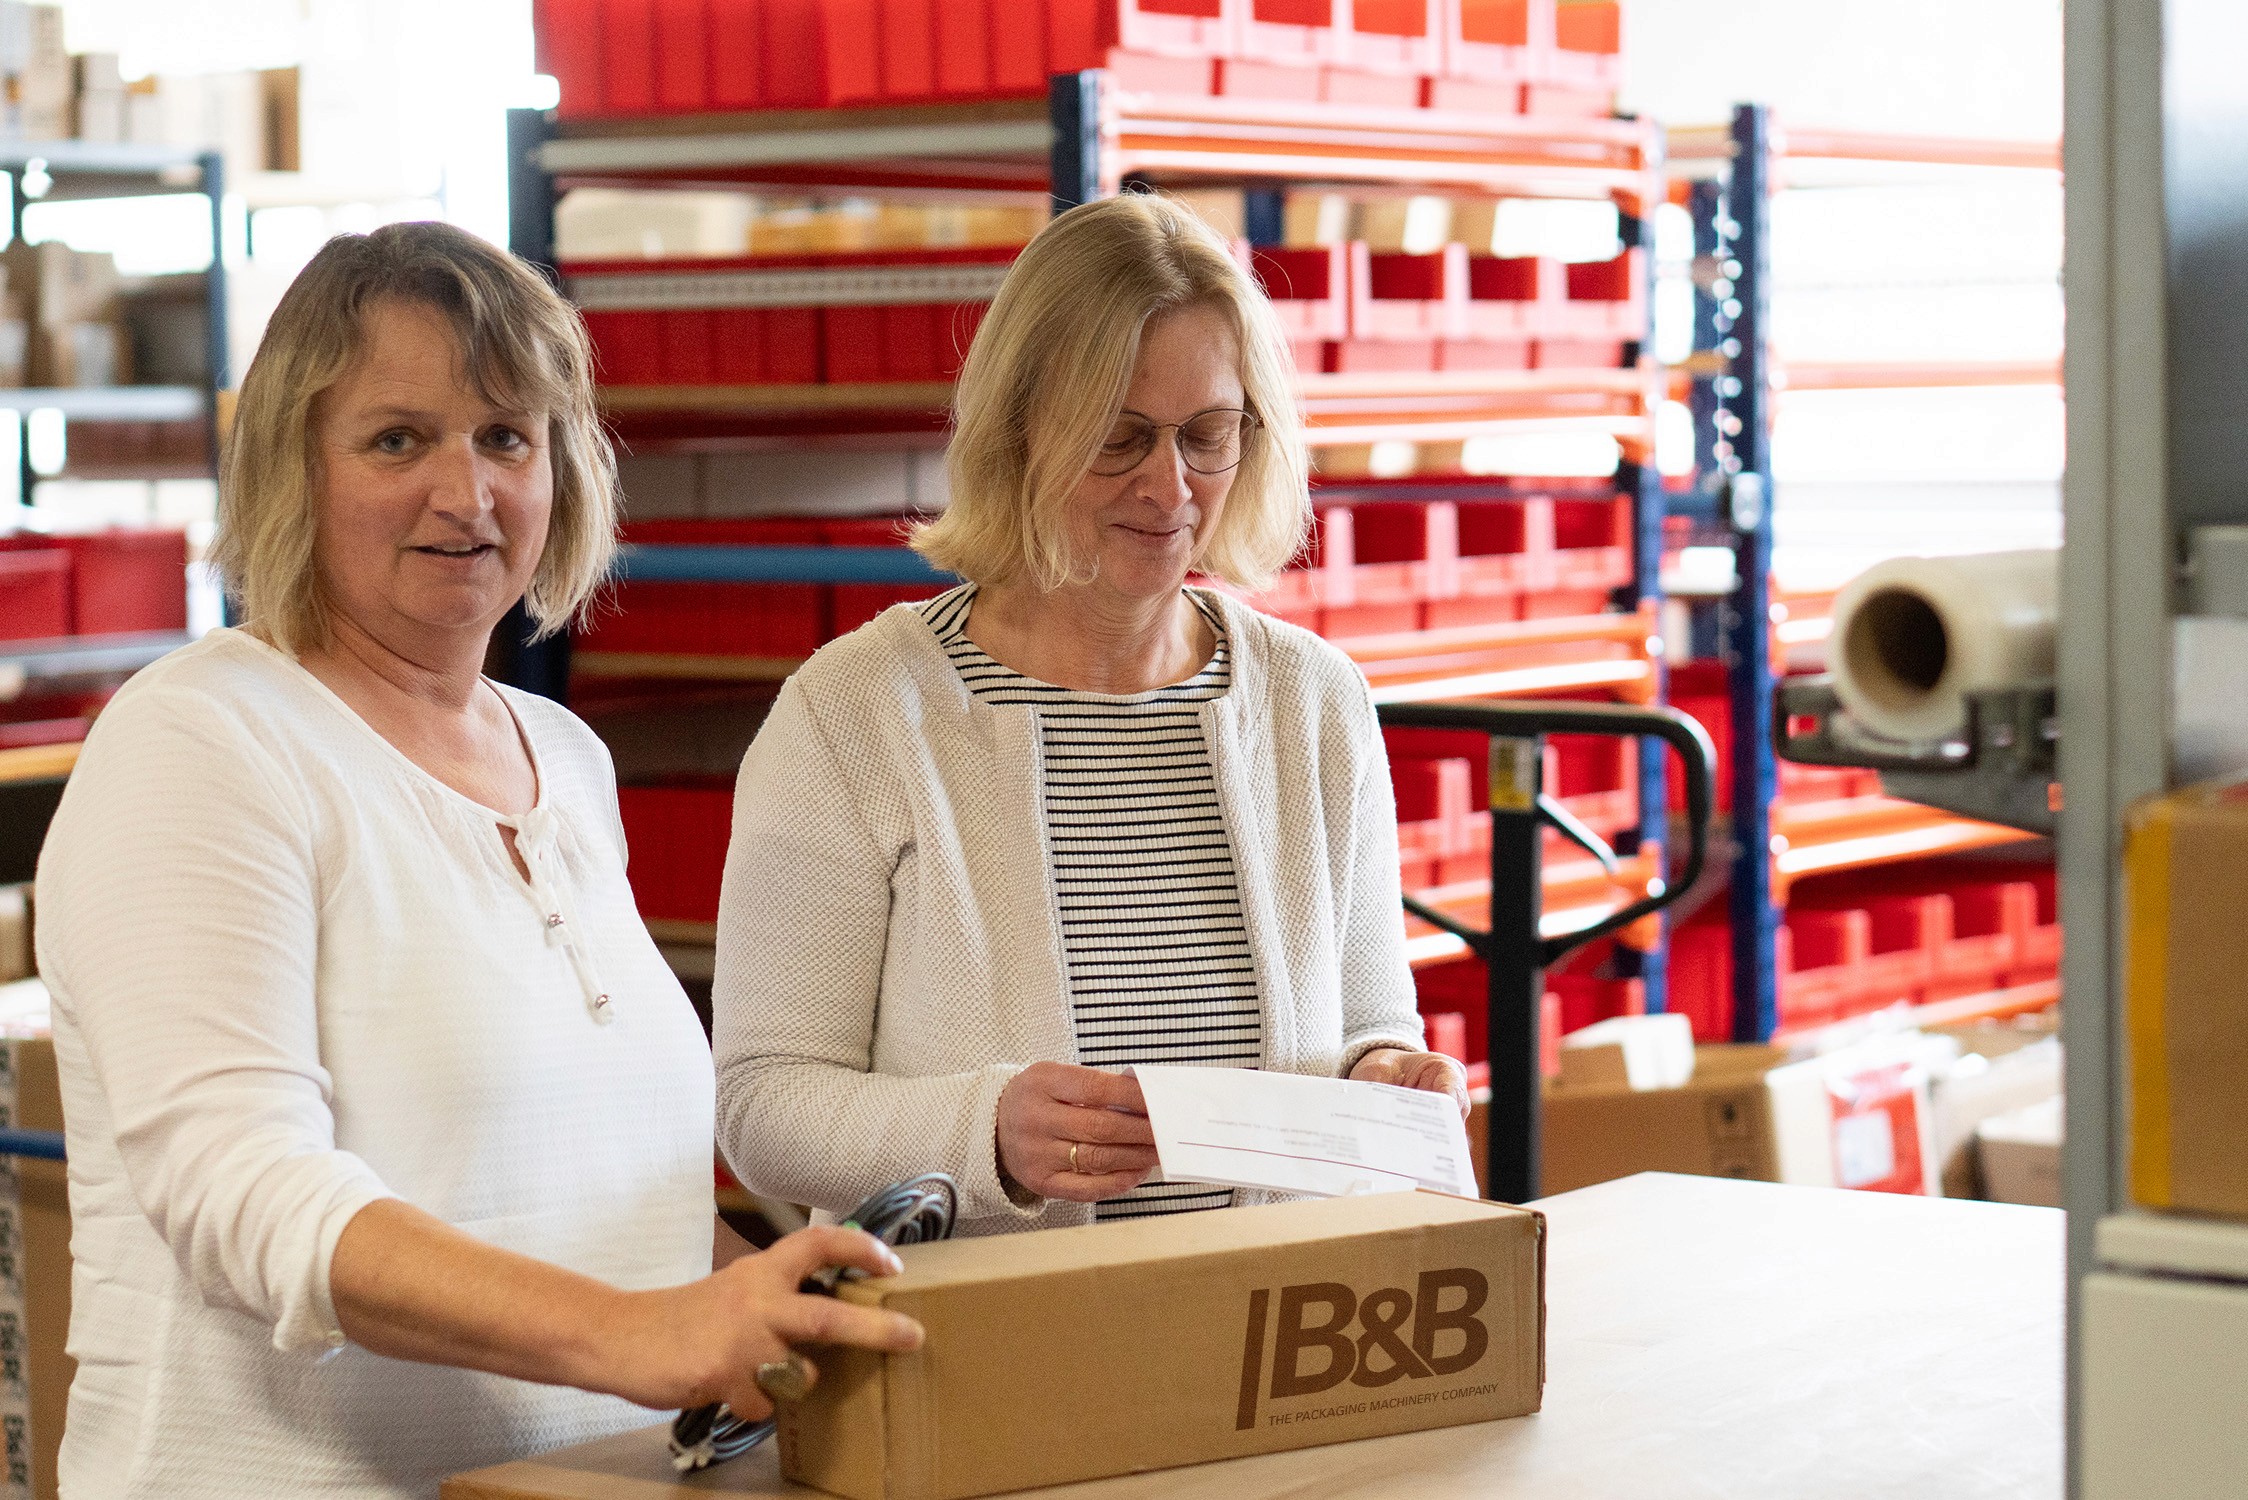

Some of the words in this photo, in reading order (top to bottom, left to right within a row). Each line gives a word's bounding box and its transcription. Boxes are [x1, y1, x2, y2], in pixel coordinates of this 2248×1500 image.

[1269, 1267, 1489, 1399] B&B
[1268, 1413, 1292, 1426] THE
[1295, 1402, 1366, 1422] PACKAGING
[1369, 1391, 1439, 1411] MACHINERY
[1441, 1383, 1499, 1400] COMPANY
